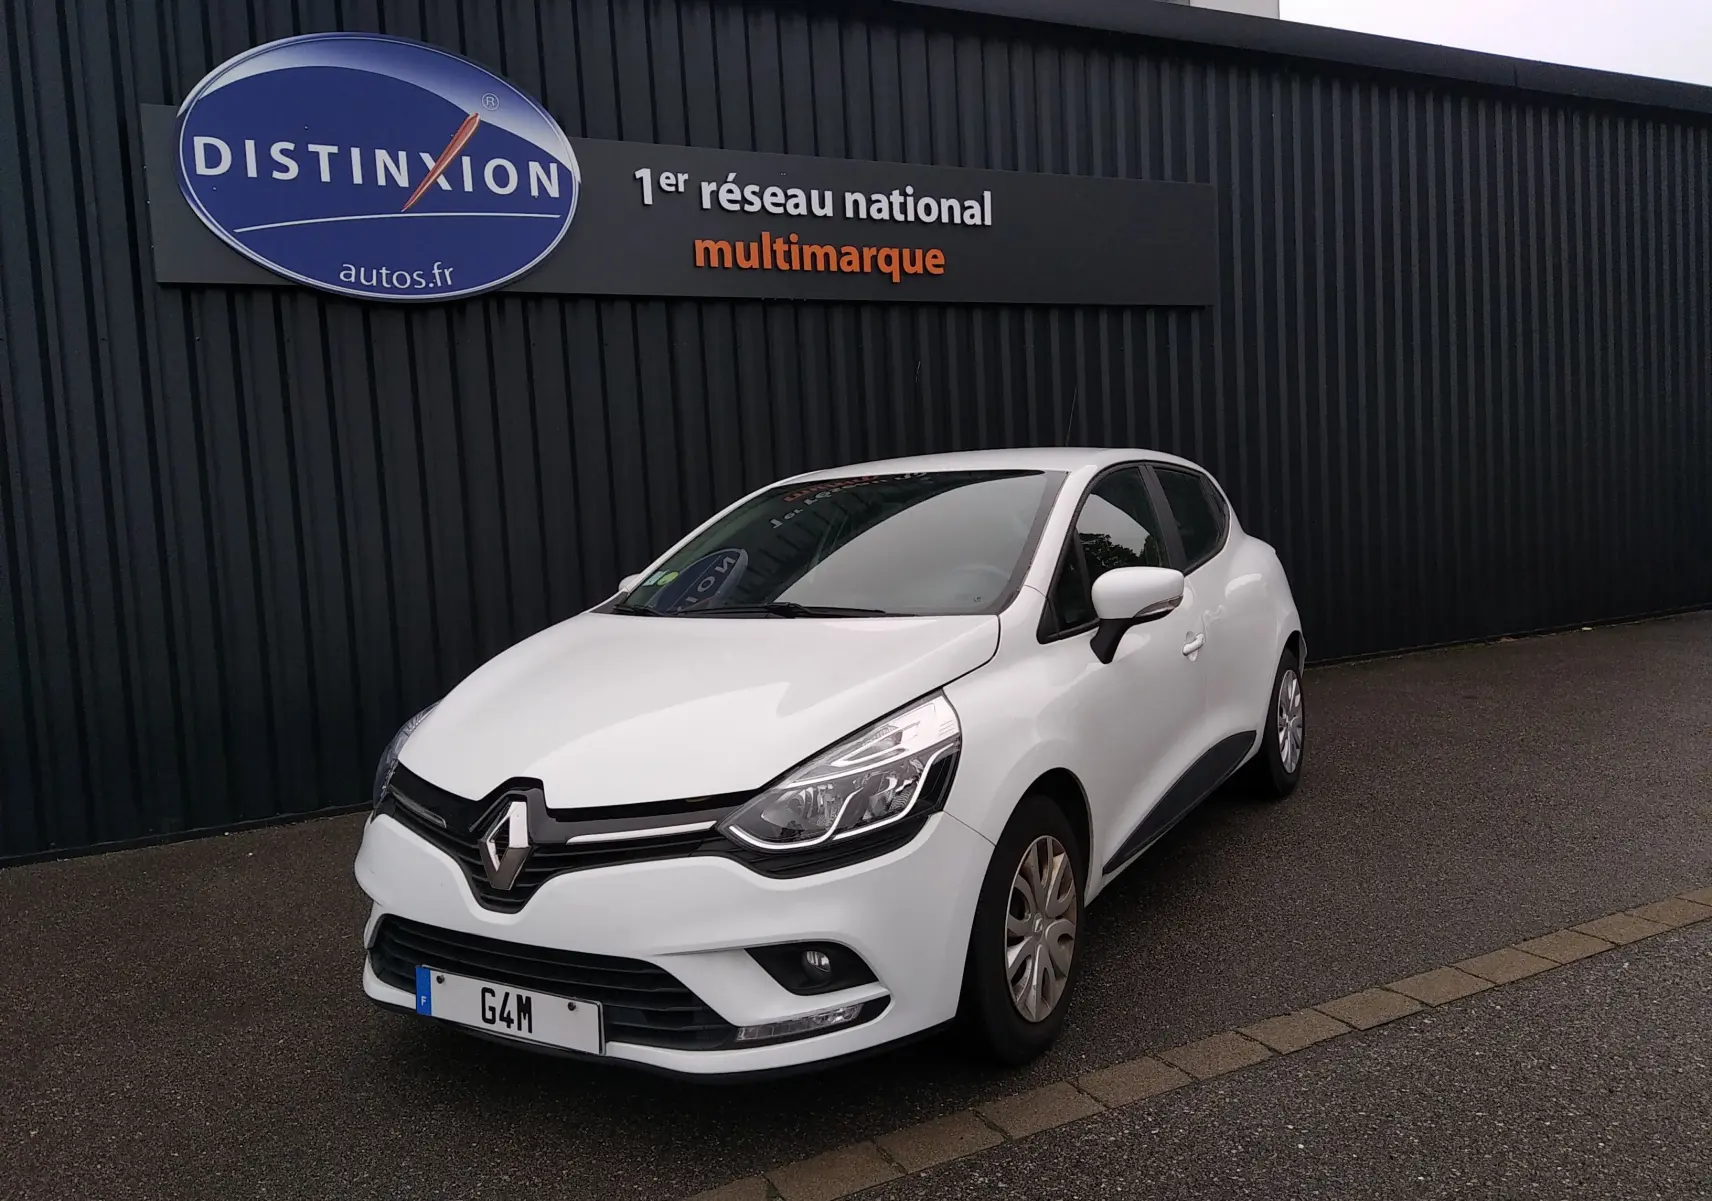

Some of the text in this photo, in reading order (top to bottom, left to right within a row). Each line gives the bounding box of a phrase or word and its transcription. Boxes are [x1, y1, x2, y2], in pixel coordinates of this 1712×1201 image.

[192, 113, 561, 212] DISTINXION
[634, 167, 993, 226] 1er réseau national
[339, 261, 455, 290] autos.fr
[693, 230, 946, 283] multimarque
[420, 995, 427, 1007] F
[481, 986, 533, 1034] G4M
